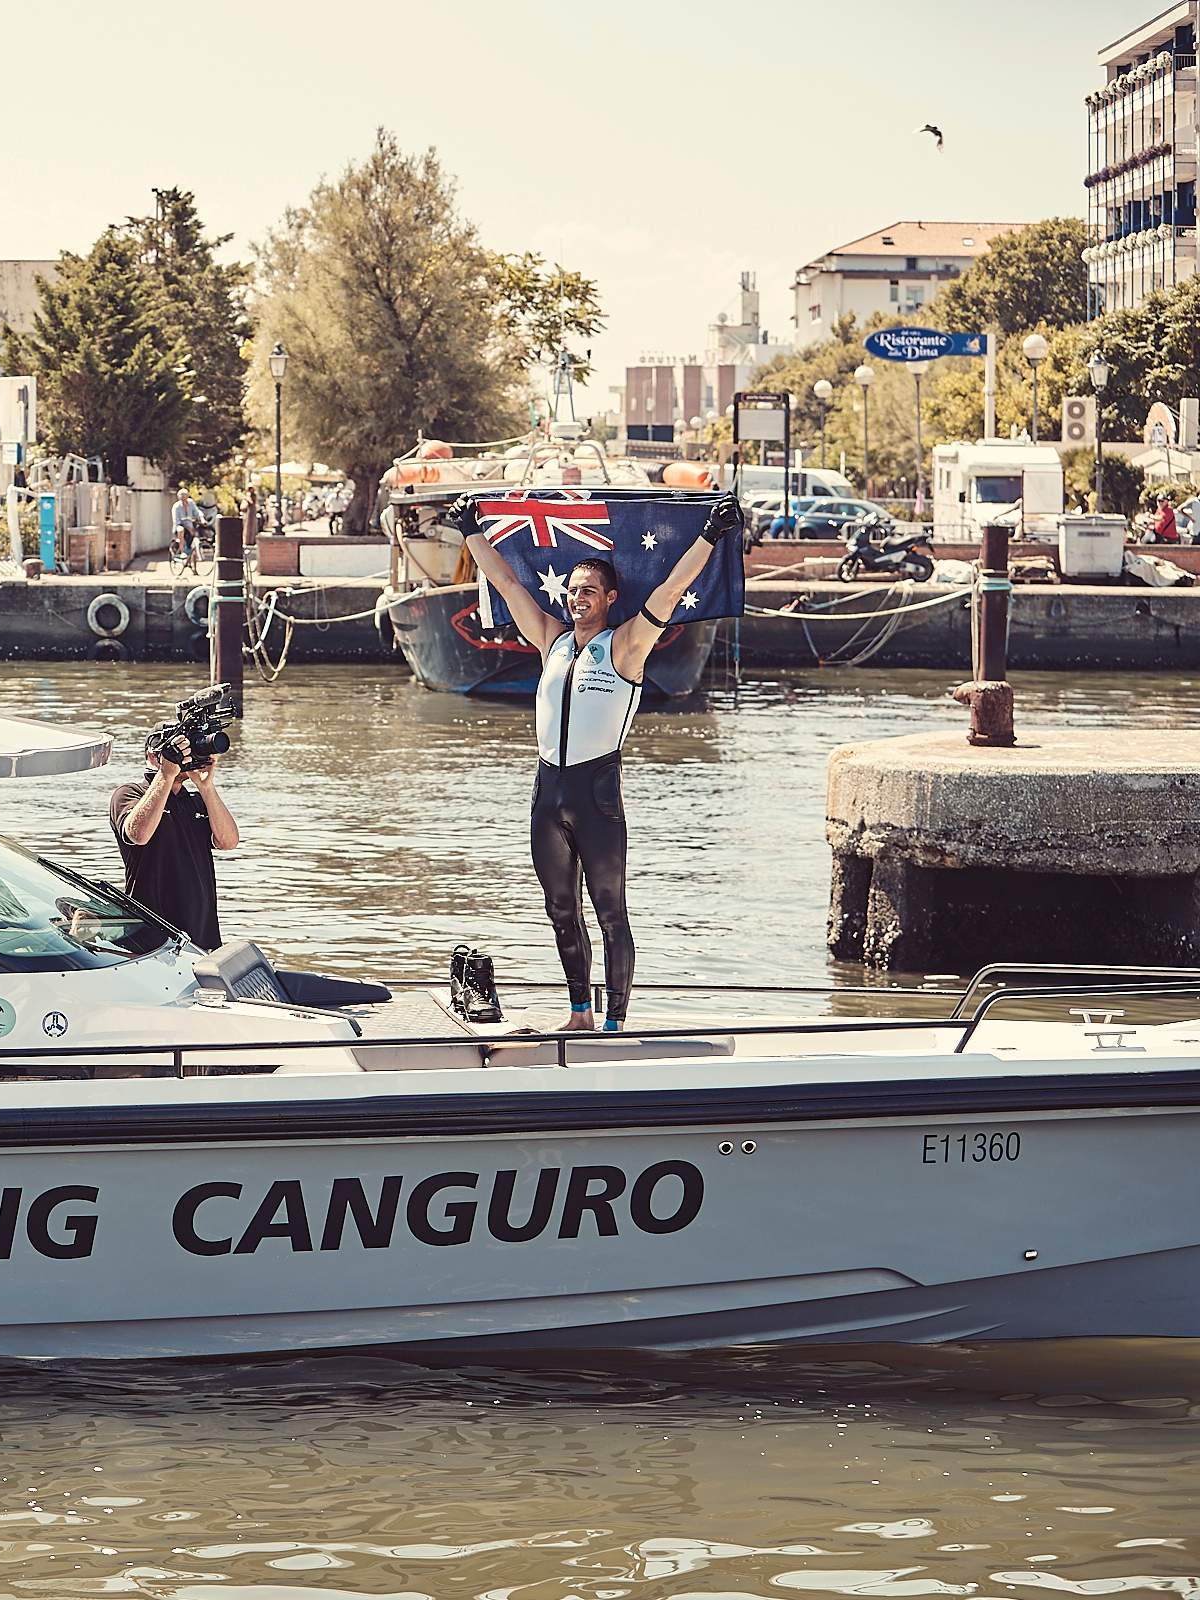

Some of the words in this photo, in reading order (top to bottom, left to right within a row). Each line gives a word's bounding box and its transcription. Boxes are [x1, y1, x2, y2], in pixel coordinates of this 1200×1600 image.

[874, 333, 947, 351] Ristorante
[902, 345, 939, 359] Dina
[587, 686, 615, 694] MERCURY
[922, 1131, 1021, 1165] E11360
[171, 1159, 705, 1257] CANGURO
